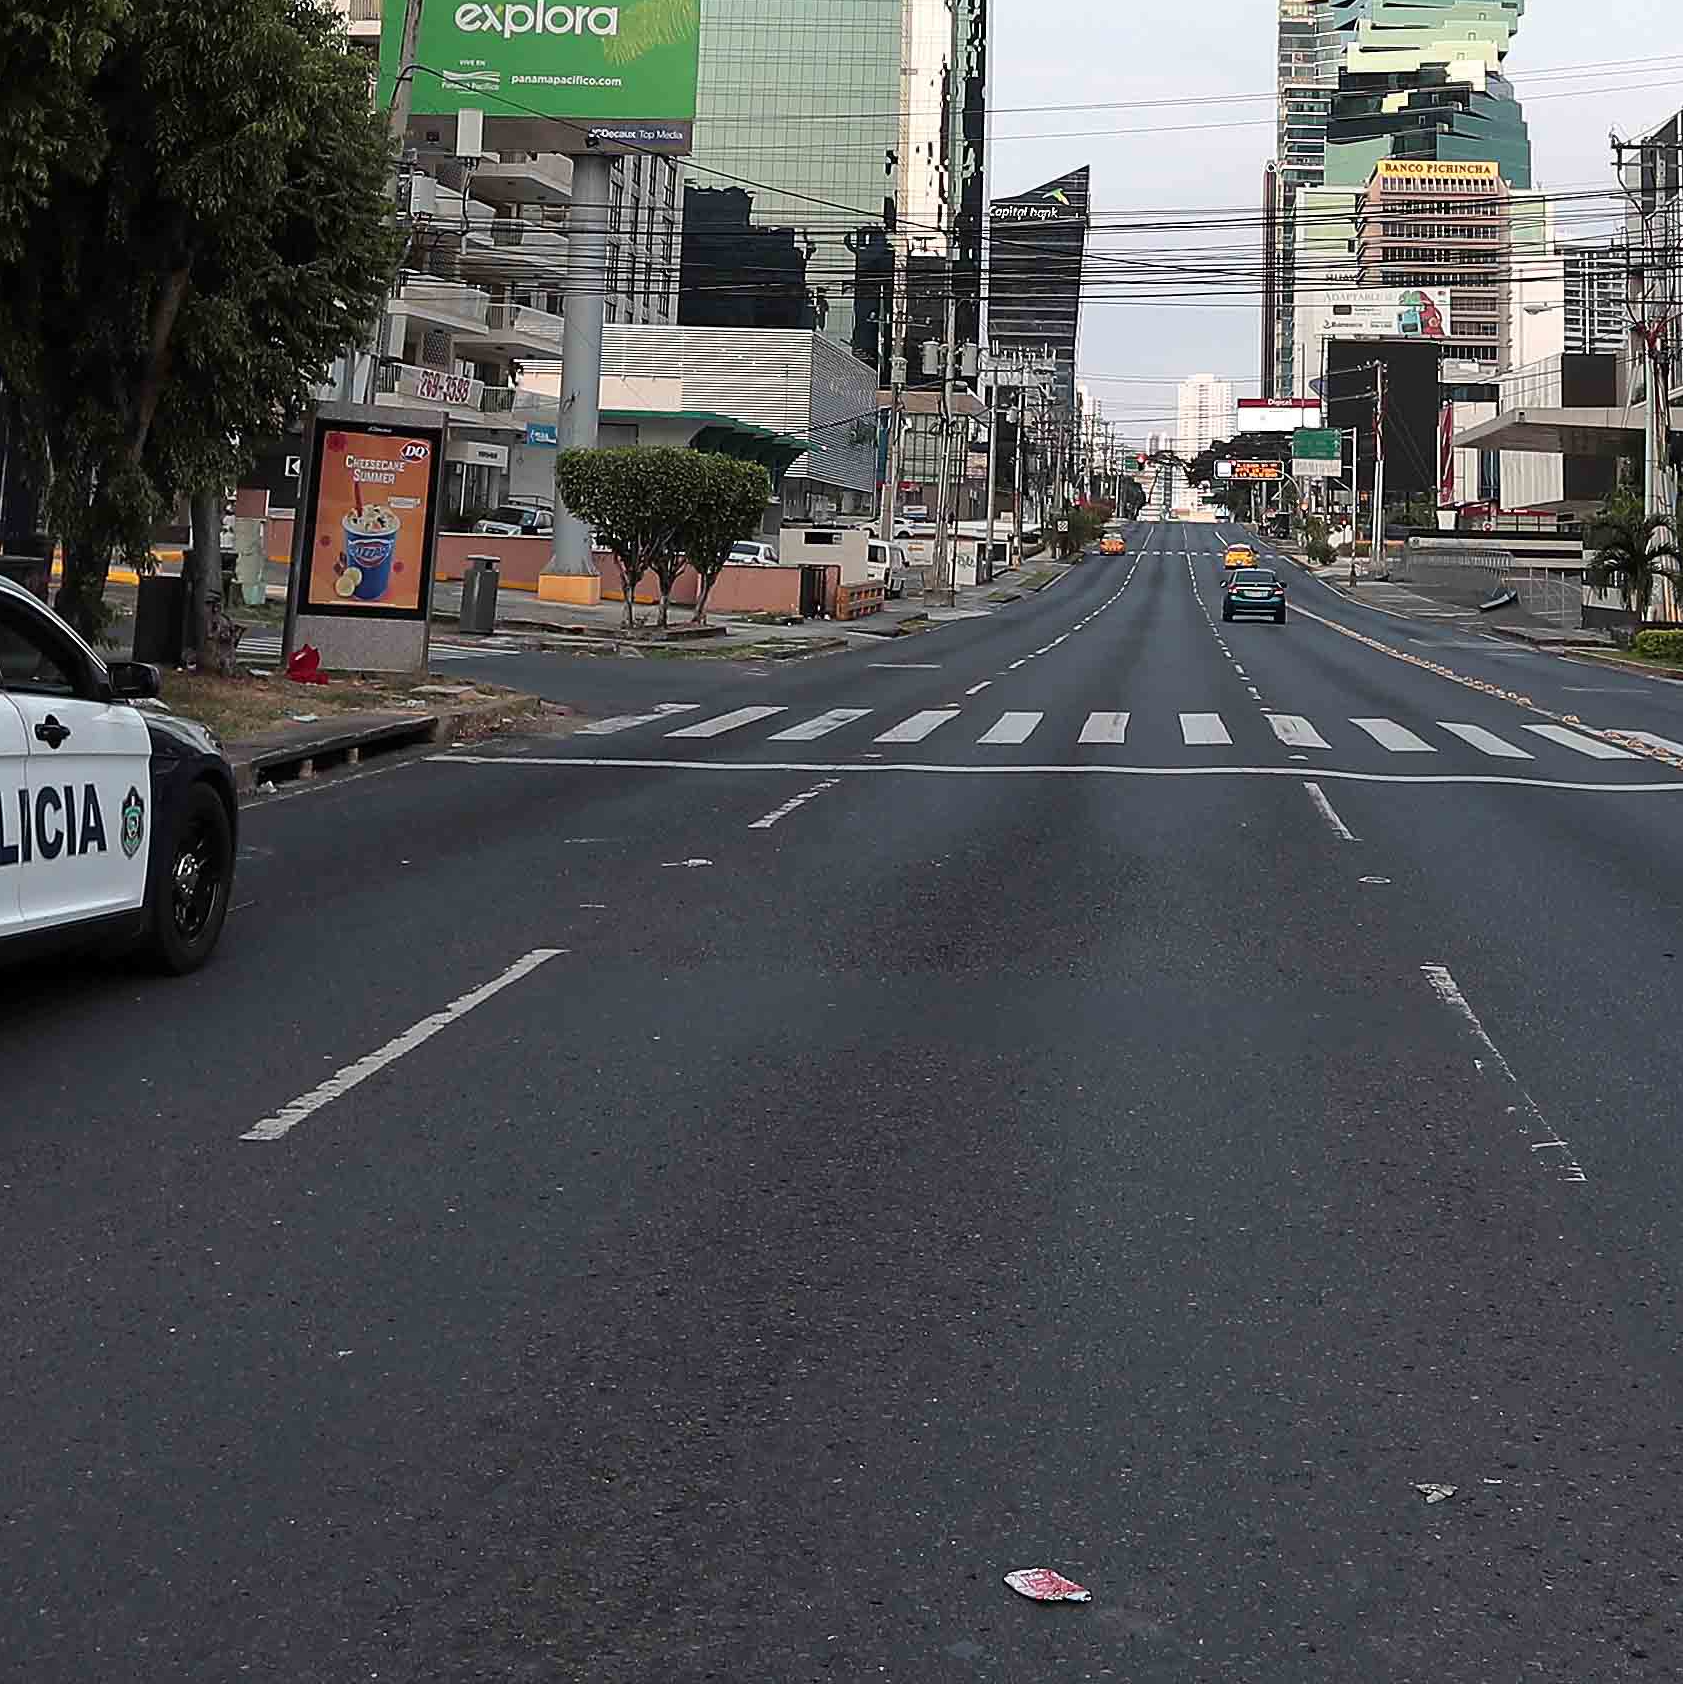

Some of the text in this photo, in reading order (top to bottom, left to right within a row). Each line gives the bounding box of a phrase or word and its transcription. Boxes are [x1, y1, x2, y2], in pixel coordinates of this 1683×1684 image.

[511, 74, 622, 87] panamapacifico.com
[639, 130, 655, 140] Top
[656, 130, 684, 140] Media
[1385, 163, 1491, 173] BANCO PICHINCHA
[405, 445, 426, 458] DQ
[352, 468, 396, 484] SUMMER
